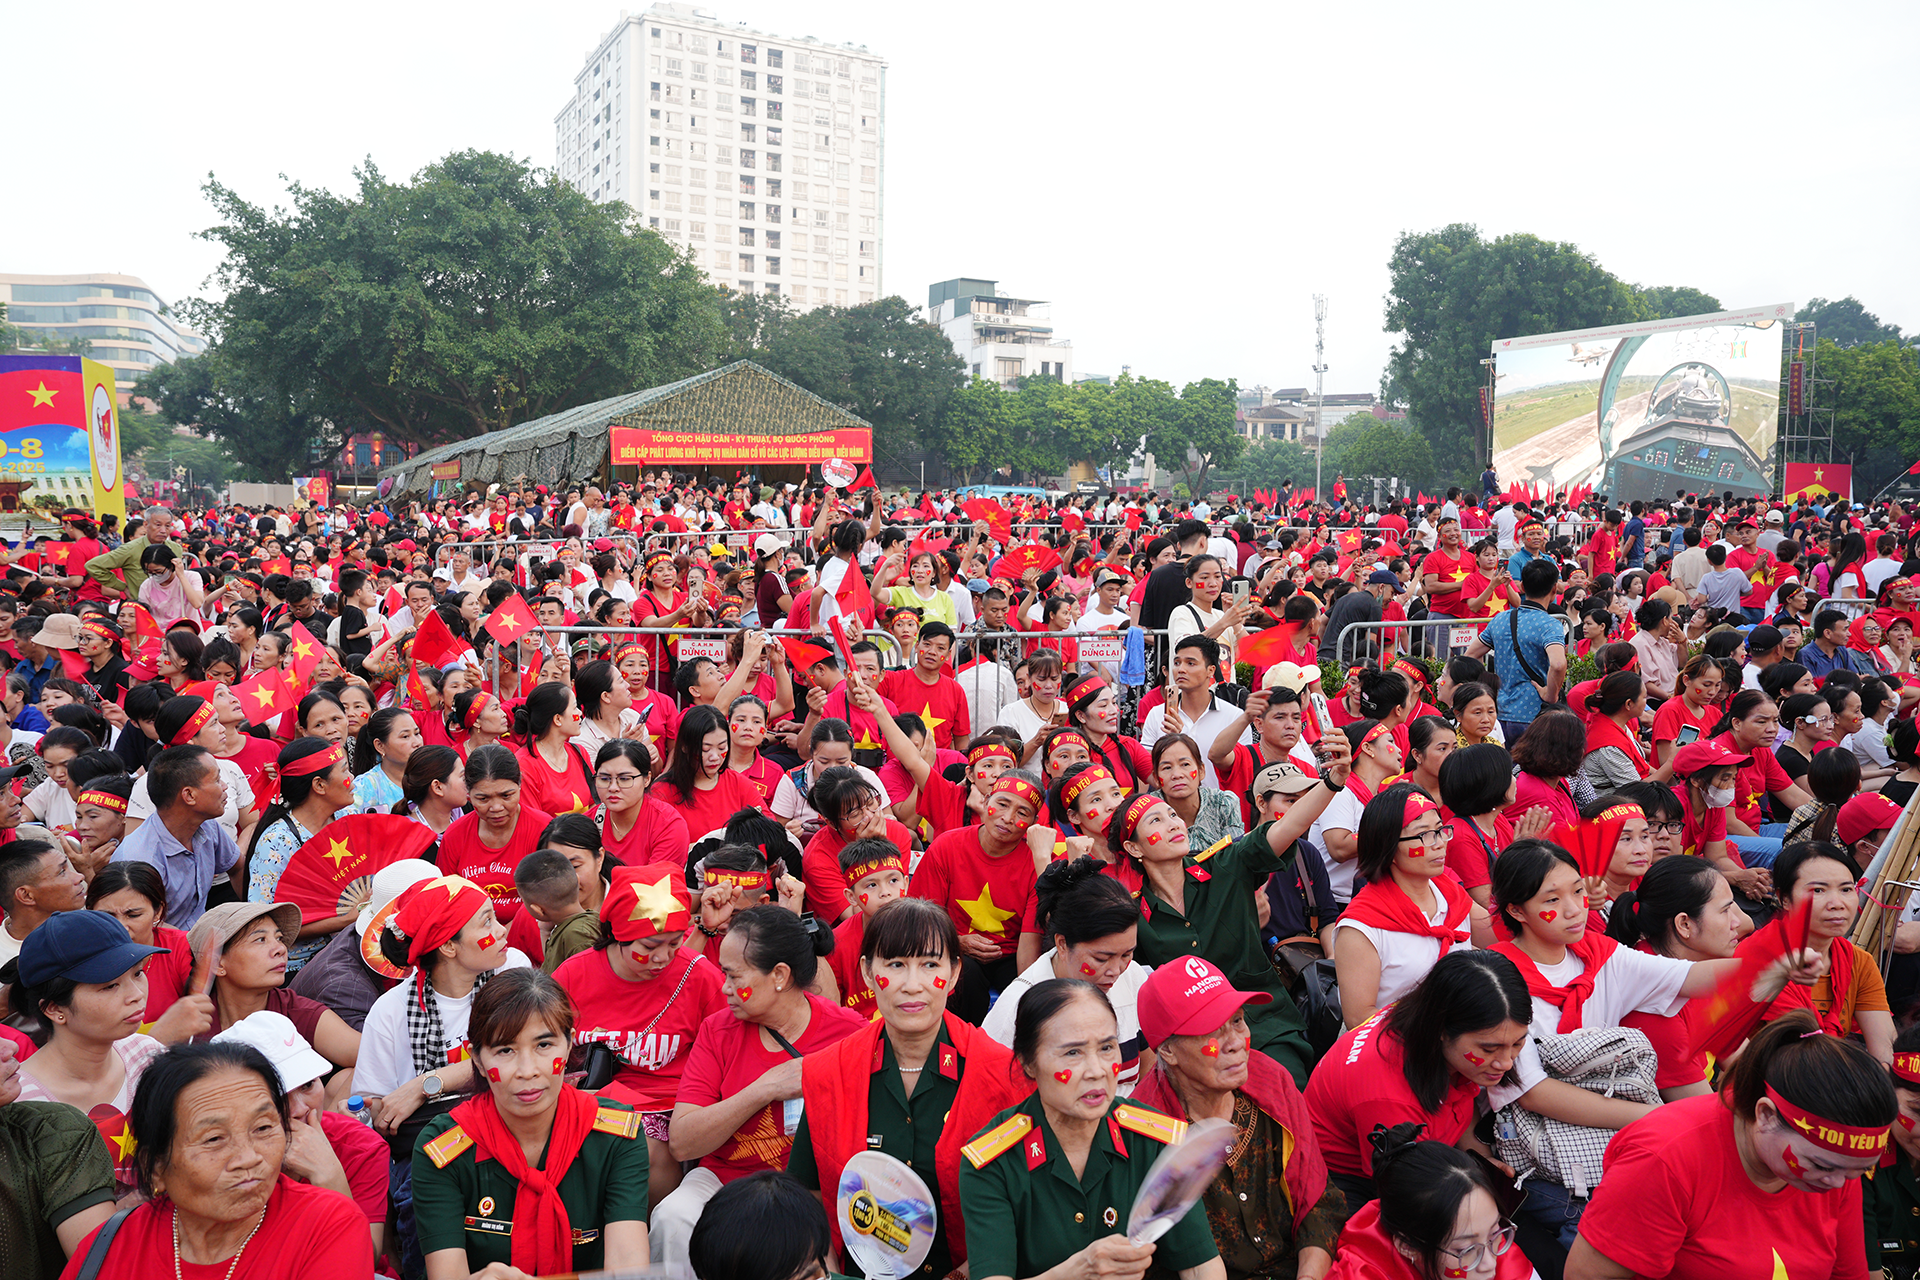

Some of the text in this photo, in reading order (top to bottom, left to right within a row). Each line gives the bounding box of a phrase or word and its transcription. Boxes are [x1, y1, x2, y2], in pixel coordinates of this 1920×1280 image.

[676, 435, 693, 444] CỤC
[695, 434, 711, 444] HẬU
[809, 434, 835, 443] PHÒNG
[637, 444, 648, 458] CẤP
[650, 446, 664, 458] PHÁT
[665, 446, 684, 458] LƯƠNG
[698, 447, 712, 460] PHỤC
[713, 447, 721, 460] VỤ
[722, 446, 737, 458] NHÂN
[738, 446, 749, 458] DÂN
[767, 446, 778, 458] CÁC
[849, 446, 864, 457] HÀNH
[0, 462, 45, 473] -2025
[682, 647, 723, 658] DỪNG LẠI
[1082, 648, 1104, 656] DỪNG
[1406, 666, 1420, 679] NAM
[199, 706, 210, 720] TÔI
[1066, 735, 1080, 744] VIỆT
[1068, 776, 1091, 799] TÔI YÊU
[89, 793, 104, 804] VIỆT
[104, 796, 120, 809] NAM
[1600, 809, 1614, 821] TÔI
[1614, 805, 1629, 816] YÊU
[332, 853, 368, 882] VIỆT NAM
[462, 861, 512, 879] Niệm Chùa
[1199, 980, 1222, 994] GROUP
[1346, 1029, 1372, 1065] NAM
[1850, 1134, 1875, 1150] YÊU
[864, 1206, 873, 1225] 3
